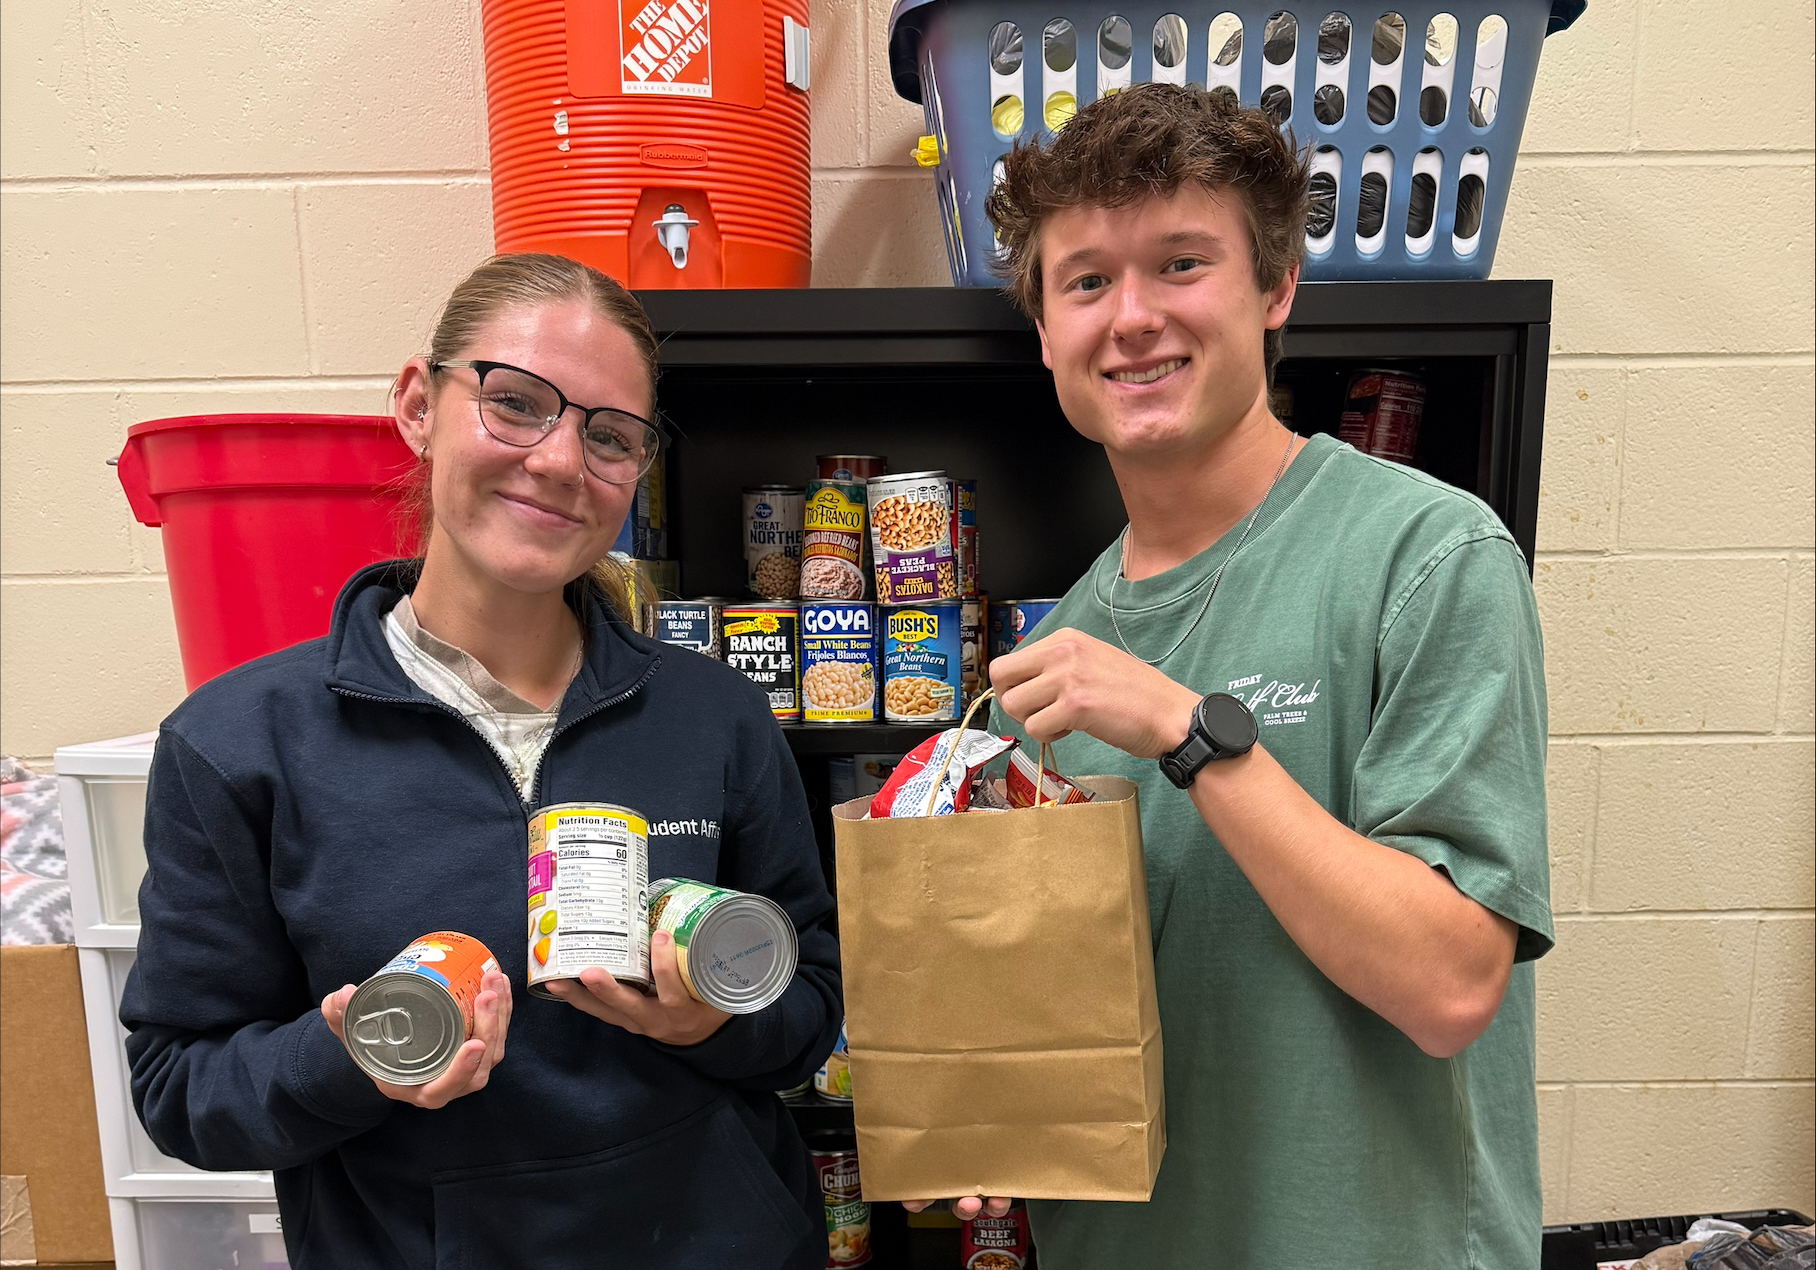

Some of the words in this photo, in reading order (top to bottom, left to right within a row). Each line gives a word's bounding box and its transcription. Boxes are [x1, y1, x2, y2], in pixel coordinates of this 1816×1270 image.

[629, 0, 667, 35] THE
[623, 0, 708, 82] HOME
[657, 25, 709, 82] DEPOT
[679, 86, 707, 94] WATER
[645, 150, 703, 162] Rubbermaid
[817, 504, 861, 528] FRANCO
[753, 521, 780, 530] GREAT
[784, 546, 803, 558] BE
[899, 557, 926, 566] PEAS
[891, 563, 936, 574] BLACKEYE
[680, 610, 706, 620] TURTLE
[668, 621, 692, 630] BEANS
[805, 609, 869, 634] GOYA
[890, 617, 936, 635] BUSH'S
[730, 636, 787, 651] RANCH
[804, 640, 821, 650] Small
[822, 640, 849, 650] White
[850, 640, 872, 649] Beans
[808, 650, 836, 661] Frijoles
[837, 651, 868, 660] Blancos
[885, 654, 902, 666] Great
[903, 652, 946, 666] Northern
[727, 654, 792, 670] STYLE
[899, 663, 922, 671] Beans
[1228, 674, 1263, 690] FRIDAY
[1271, 679, 1322, 708] Club
[1263, 712, 1280, 720] PALM
[558, 816, 600, 826] Nutrition
[603, 817, 627, 828] Facts
[558, 848, 590, 857] Calories
[616, 848, 628, 860] 60
[973, 1218, 1018, 1229] Southgate
[980, 1229, 1011, 1239] BEEF
[974, 1237, 1017, 1247] LASAGNA
